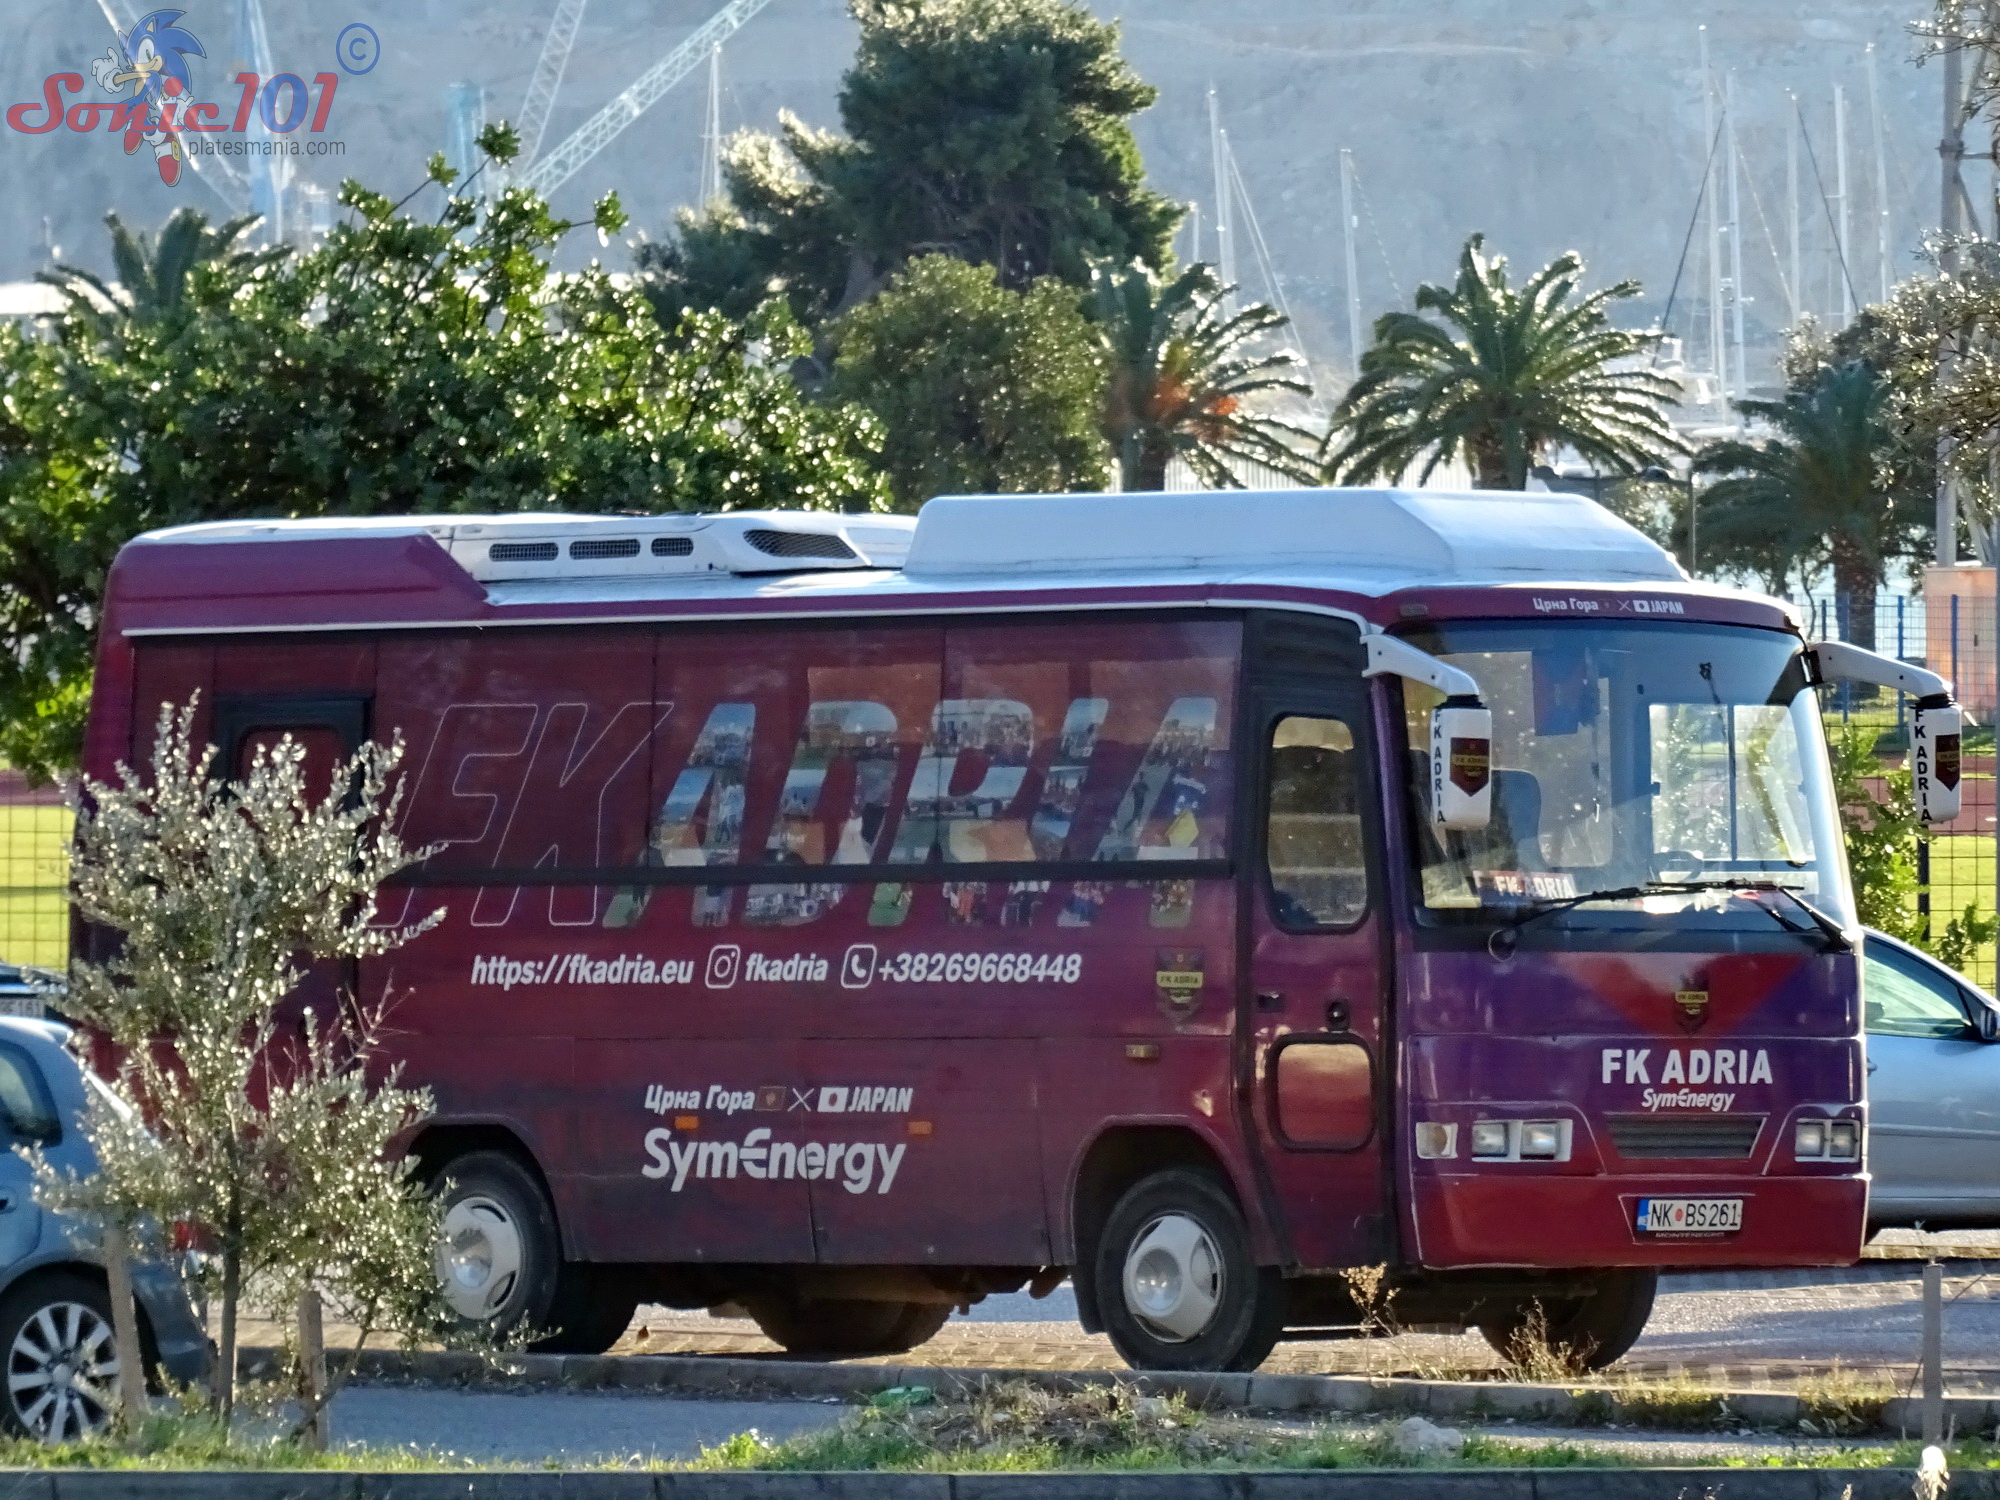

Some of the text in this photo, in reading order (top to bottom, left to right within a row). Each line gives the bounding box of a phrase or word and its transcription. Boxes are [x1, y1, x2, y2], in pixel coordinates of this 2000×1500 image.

[1533, 598, 1567, 612] Црна
[1569, 598, 1599, 612] Гора
[1651, 601, 1685, 614] JAPAN
[1914, 708, 1932, 821] FK ADRIA
[1434, 746, 1446, 822] ADRIA
[602, 698, 1220, 928] ADRIA
[471, 953, 1083, 991] https://fkadria.eu fkadria +38269668448
[1602, 1049, 1773, 1084] FK ADRIA
[645, 1084, 700, 1116] Црна
[705, 1084, 756, 1116] Гора
[849, 1086, 914, 1112] JAPAN
[1650, 1203, 1738, 1227] NK BS261
